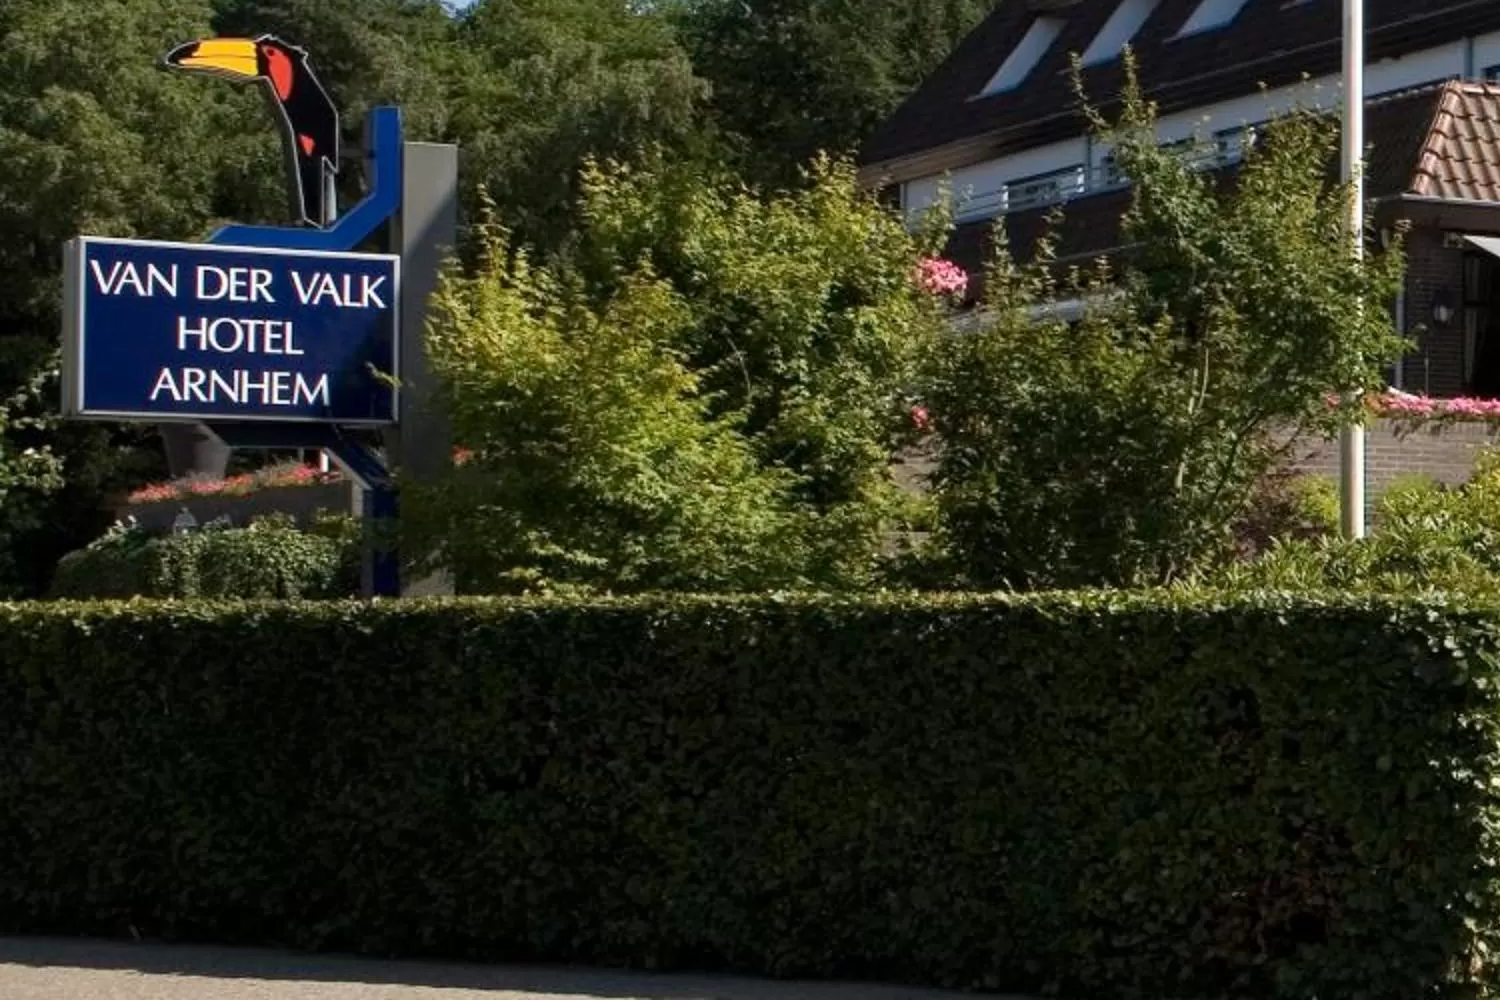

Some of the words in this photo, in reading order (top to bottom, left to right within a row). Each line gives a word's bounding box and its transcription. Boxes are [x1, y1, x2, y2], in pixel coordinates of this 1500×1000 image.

[90, 259, 178, 297] VAN
[196, 265, 276, 303] DER
[291, 271, 386, 309] VALK
[178, 316, 305, 355] HOTEL
[150, 367, 330, 406] ARNHEM
